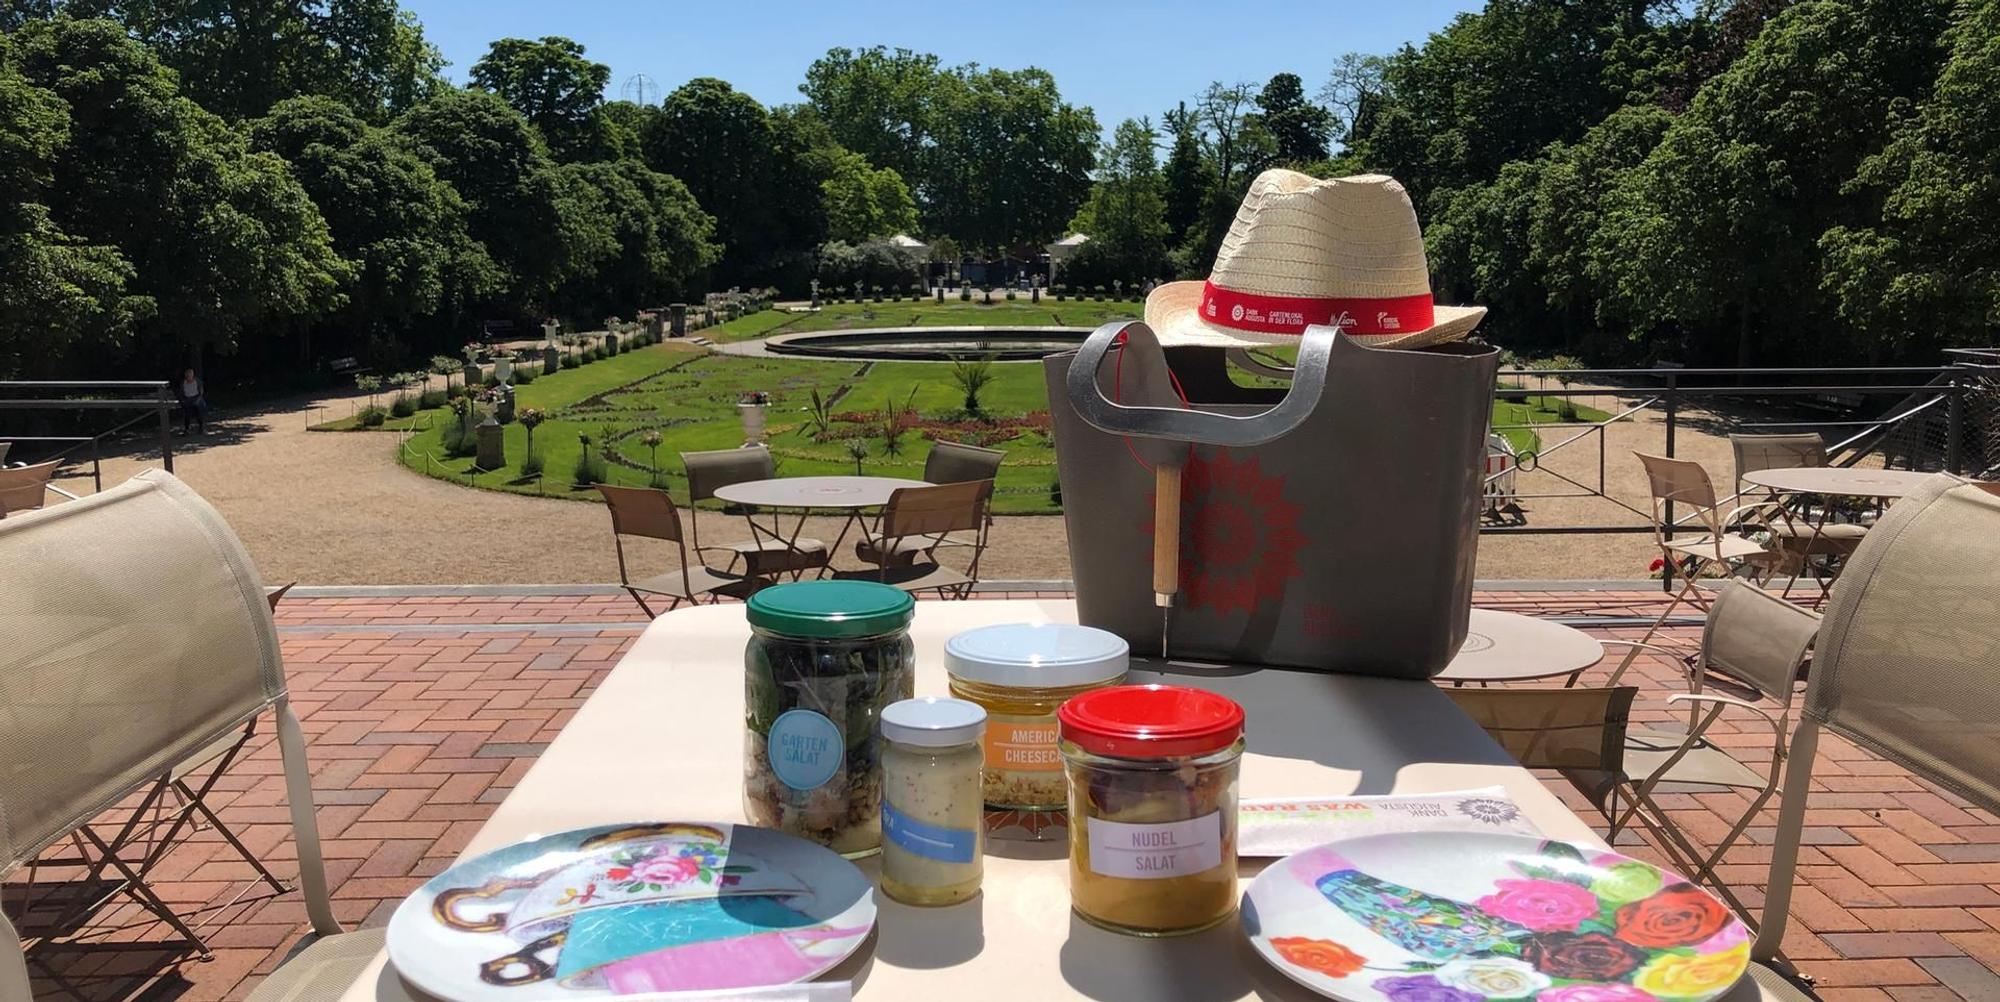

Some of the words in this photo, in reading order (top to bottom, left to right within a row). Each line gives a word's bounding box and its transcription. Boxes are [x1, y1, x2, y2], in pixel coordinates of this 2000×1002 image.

[781, 732, 828, 752] GARTEN
[783, 746, 821, 766] SALAT
[1131, 831, 1178, 848] NUDEL
[1135, 854, 1177, 871] SALAT
